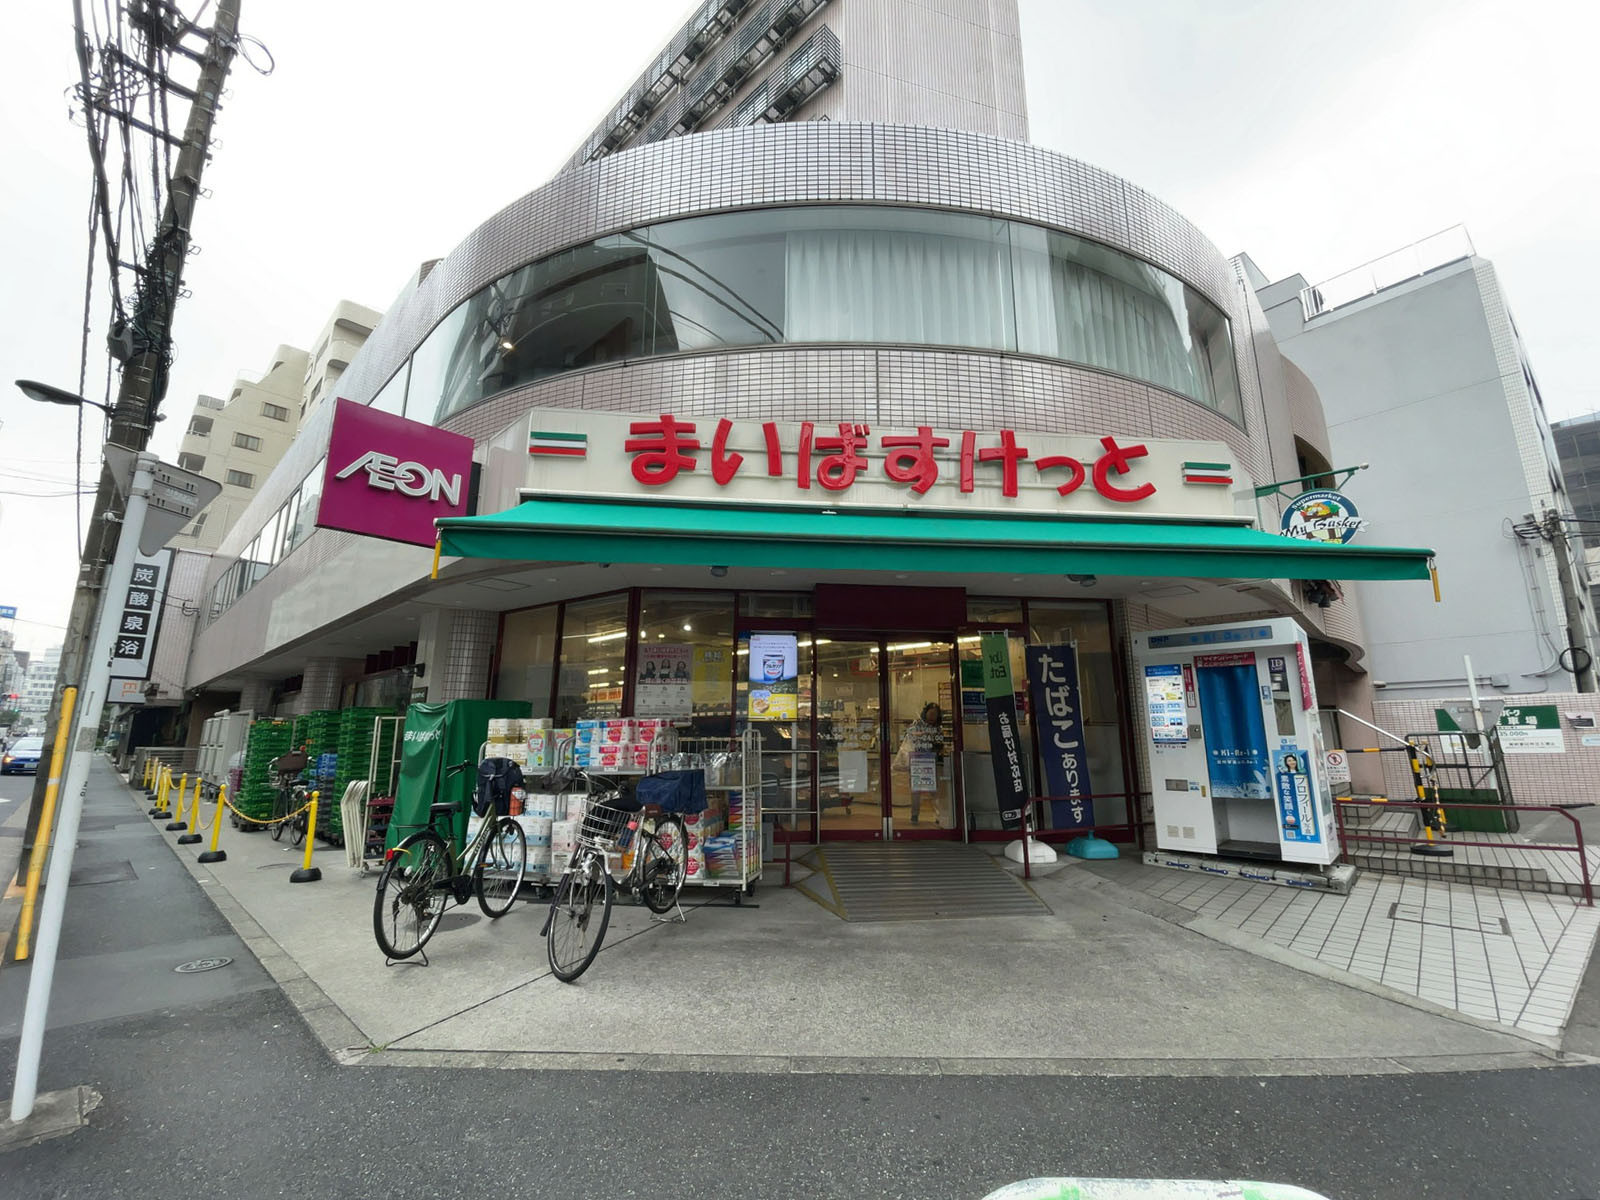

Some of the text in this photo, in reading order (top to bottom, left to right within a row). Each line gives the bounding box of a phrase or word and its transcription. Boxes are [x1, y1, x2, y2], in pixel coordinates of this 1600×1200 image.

[624, 414, 1156, 502] まいばすけっと
[335, 451, 462, 506] AEON
[1292, 493, 1341, 510] Supermarket
[1280, 516, 1362, 538] My Basket
[118, 567, 154, 656] 炭酸泉浴
[1500, 709, 1521, 717] パーク
